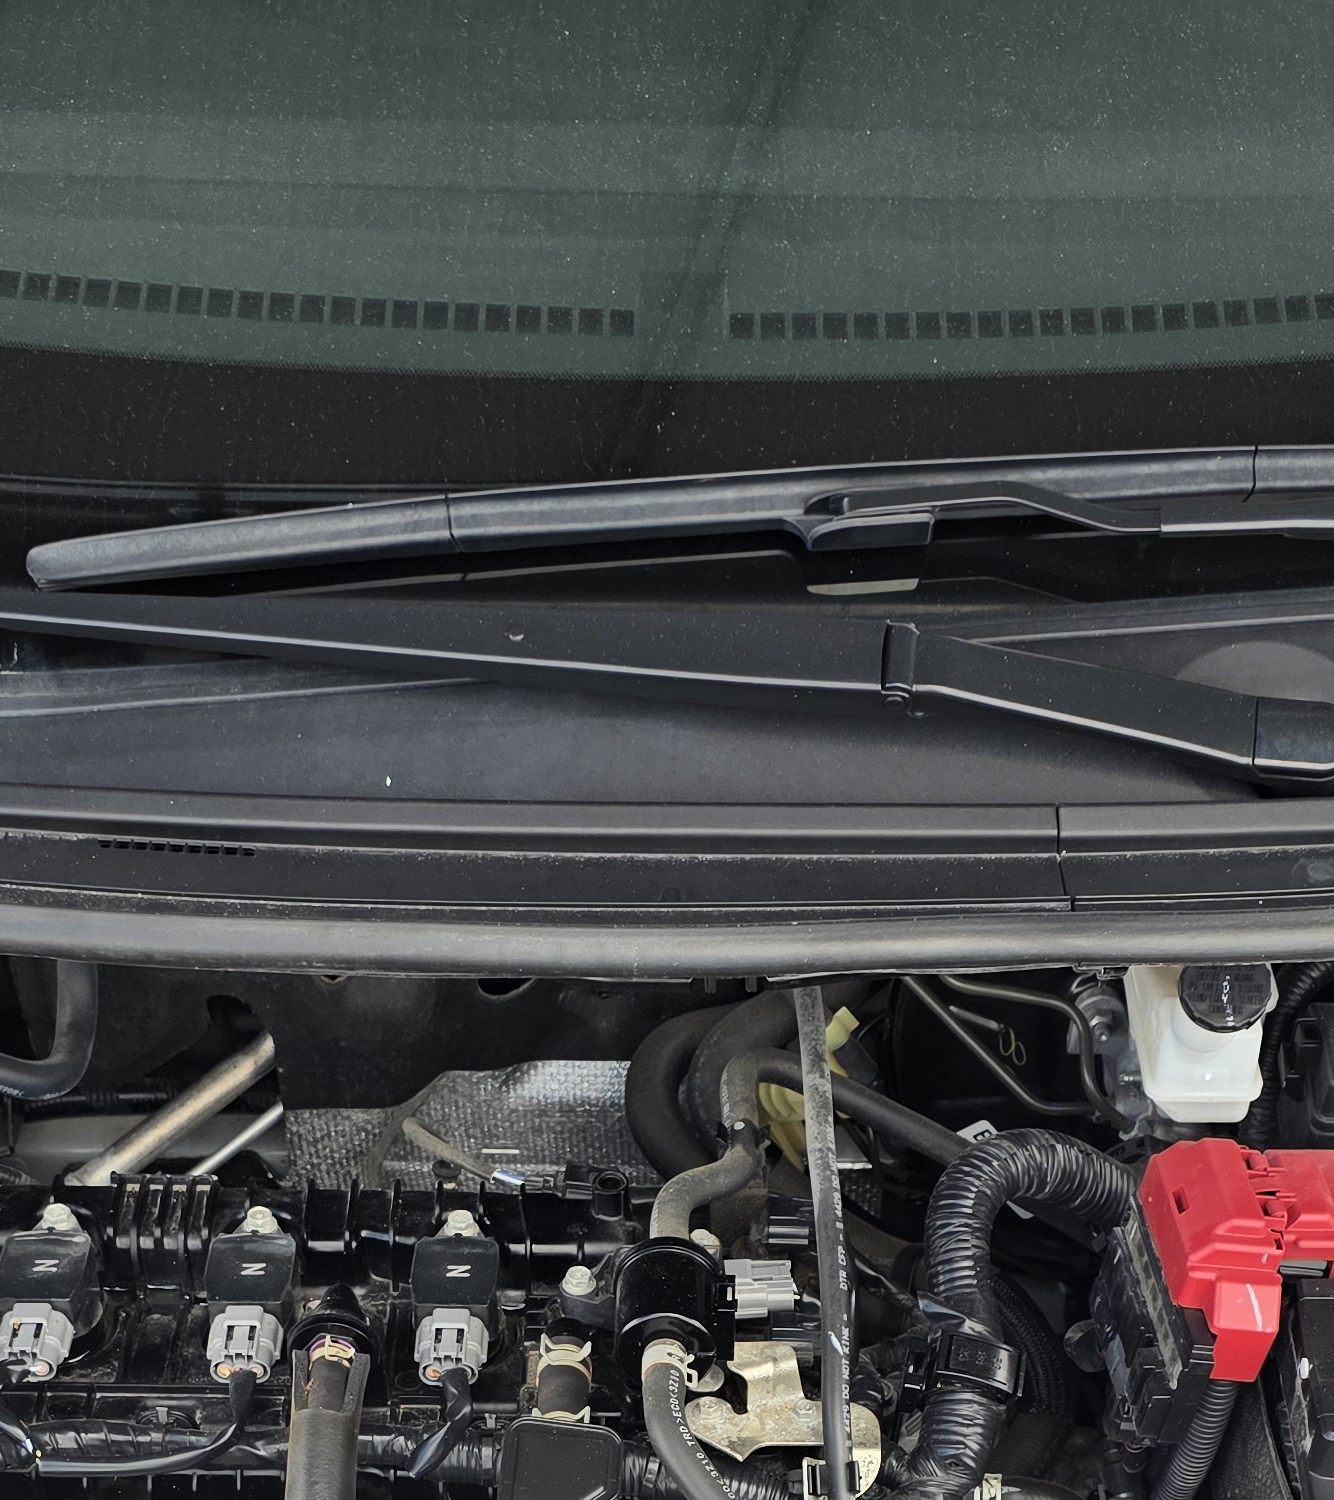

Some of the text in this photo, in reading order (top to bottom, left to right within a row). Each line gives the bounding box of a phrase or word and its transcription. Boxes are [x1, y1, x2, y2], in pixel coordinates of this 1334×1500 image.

[840, 1325, 851, 1354] KINK
[840, 1357, 850, 1379] NOT
[840, 1383, 850, 1399] DO
